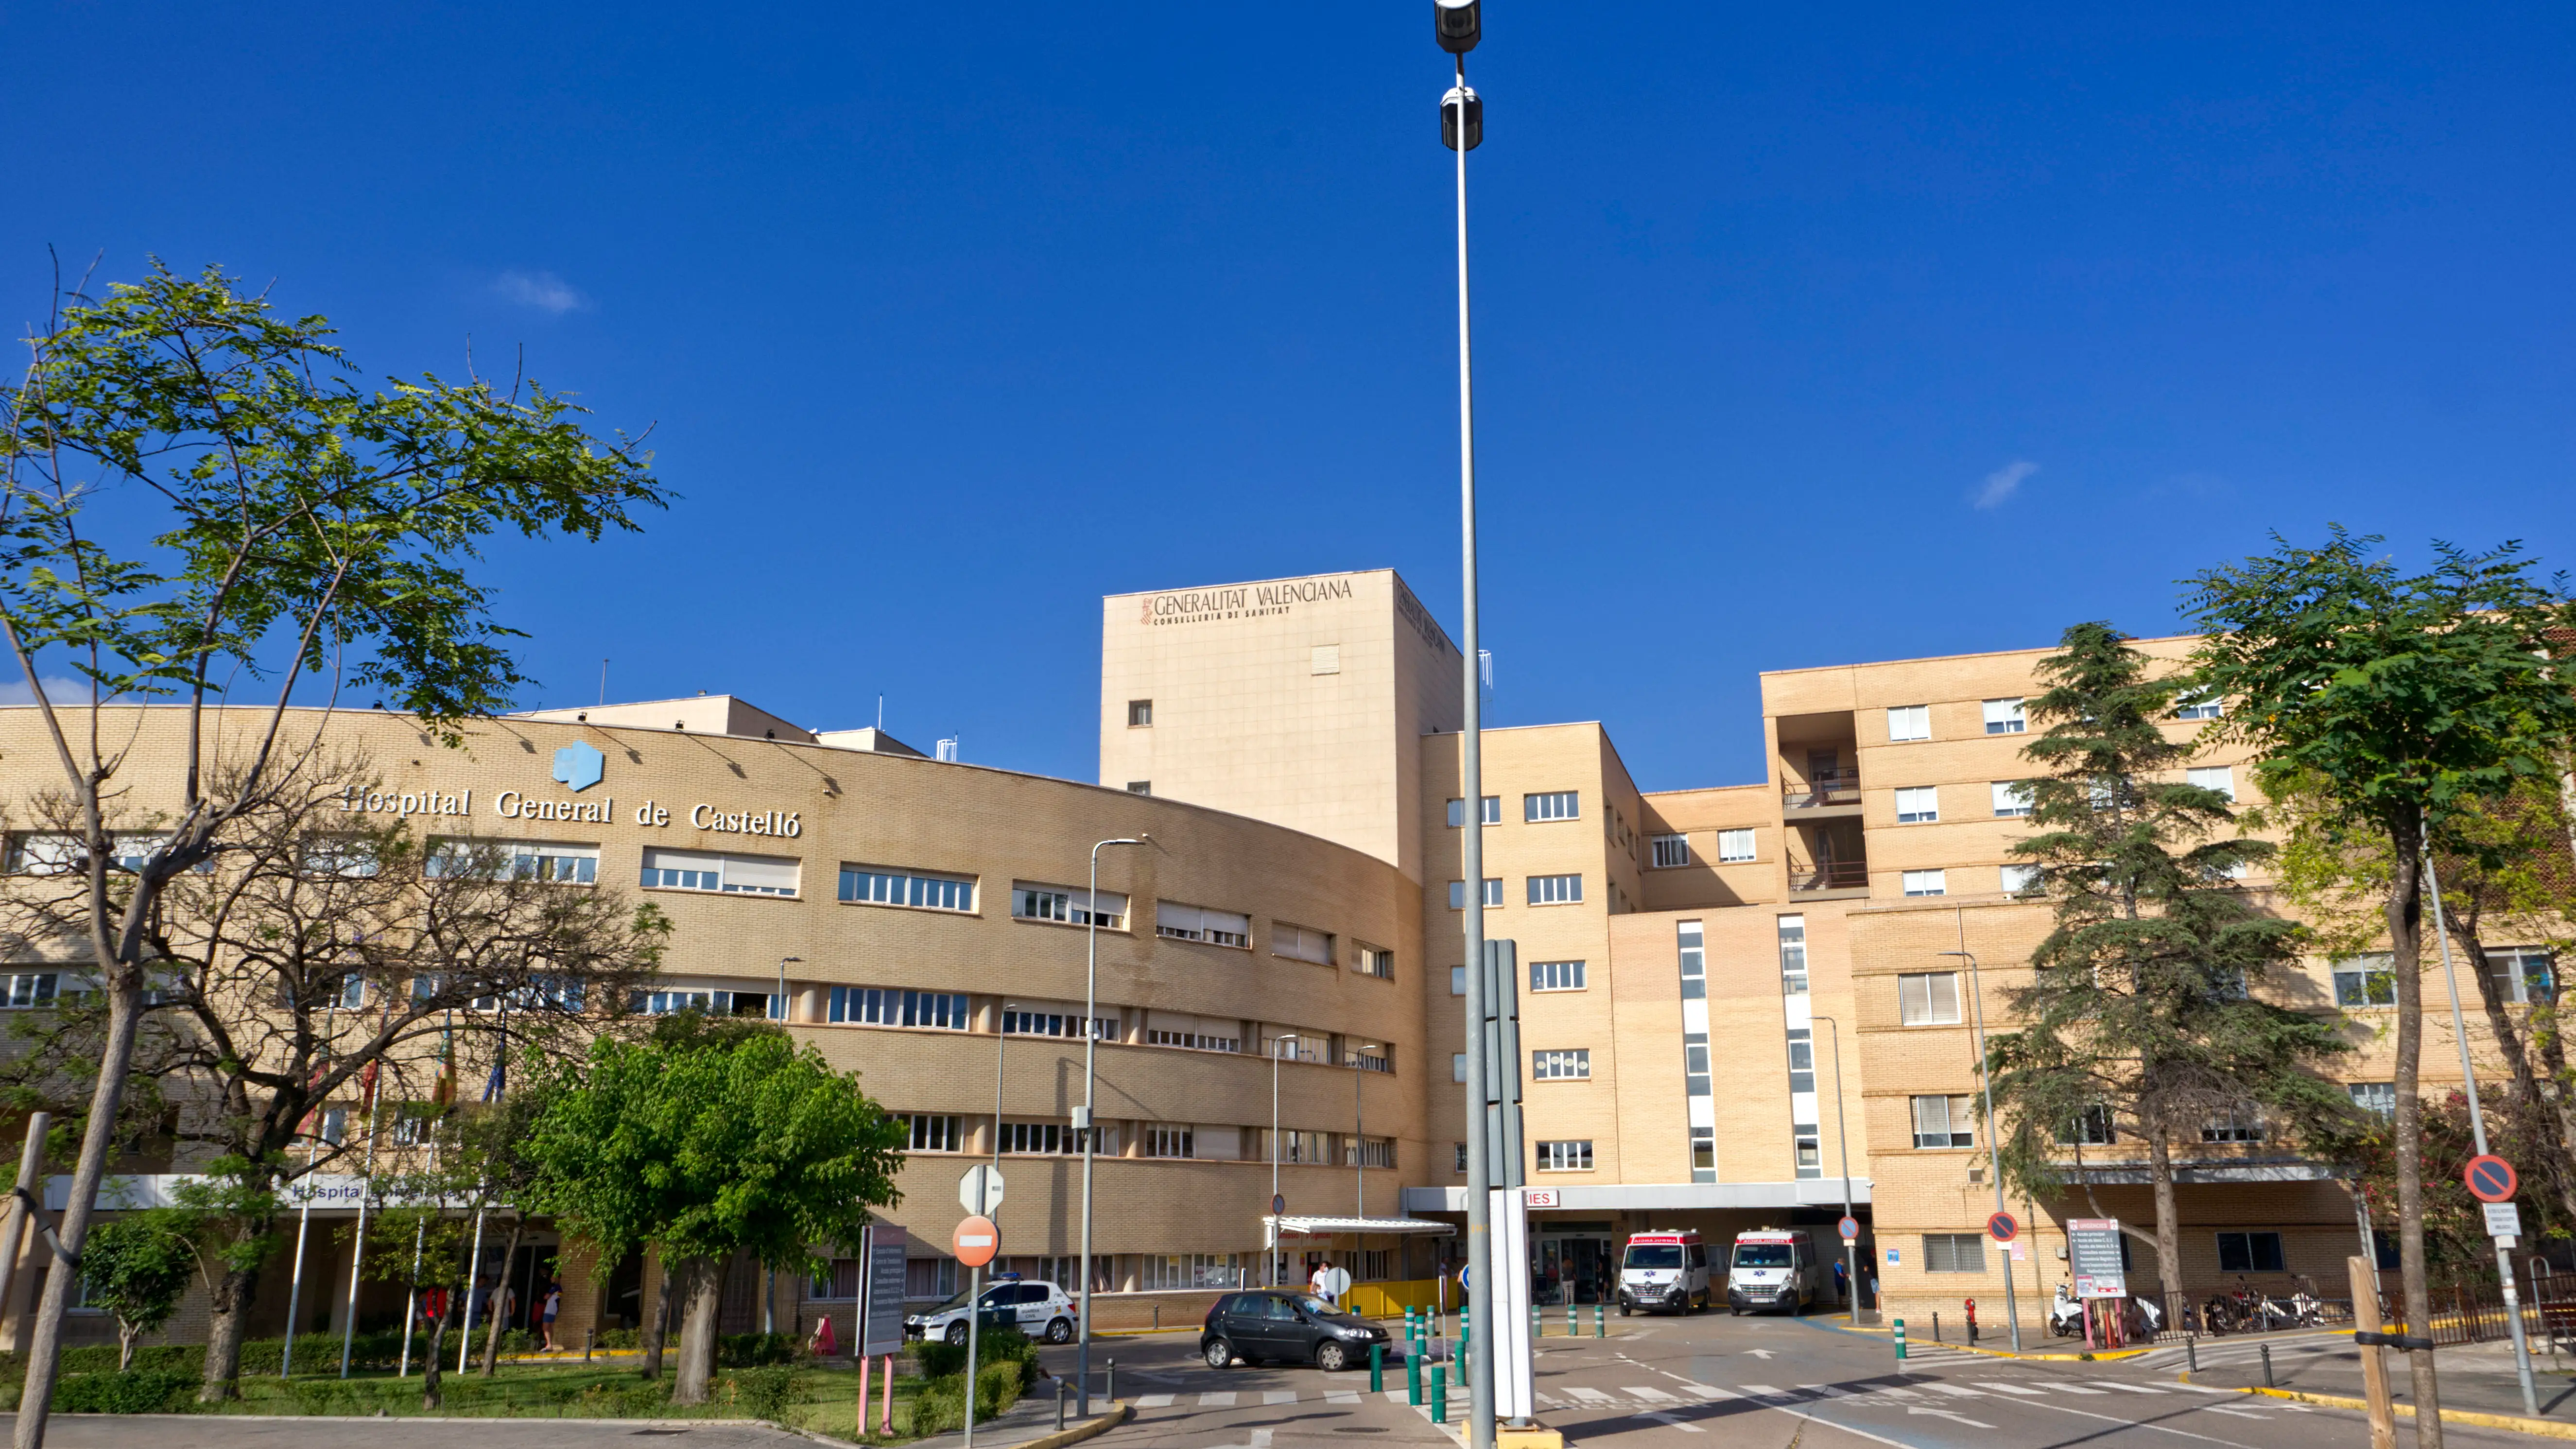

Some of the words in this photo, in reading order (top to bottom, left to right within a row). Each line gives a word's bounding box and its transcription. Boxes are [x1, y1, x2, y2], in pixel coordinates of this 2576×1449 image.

[1155, 588, 1247, 615] GENERALITAT
[1257, 579, 1352, 606] VALENCIANA
[1154, 613, 1221, 626] CONSELLERIA
[1245, 606, 1290, 618] SANITAT
[340, 785, 470, 818] Hospital
[496, 791, 614, 823] General
[637, 801, 669, 826] de
[691, 804, 801, 837] Castelló
